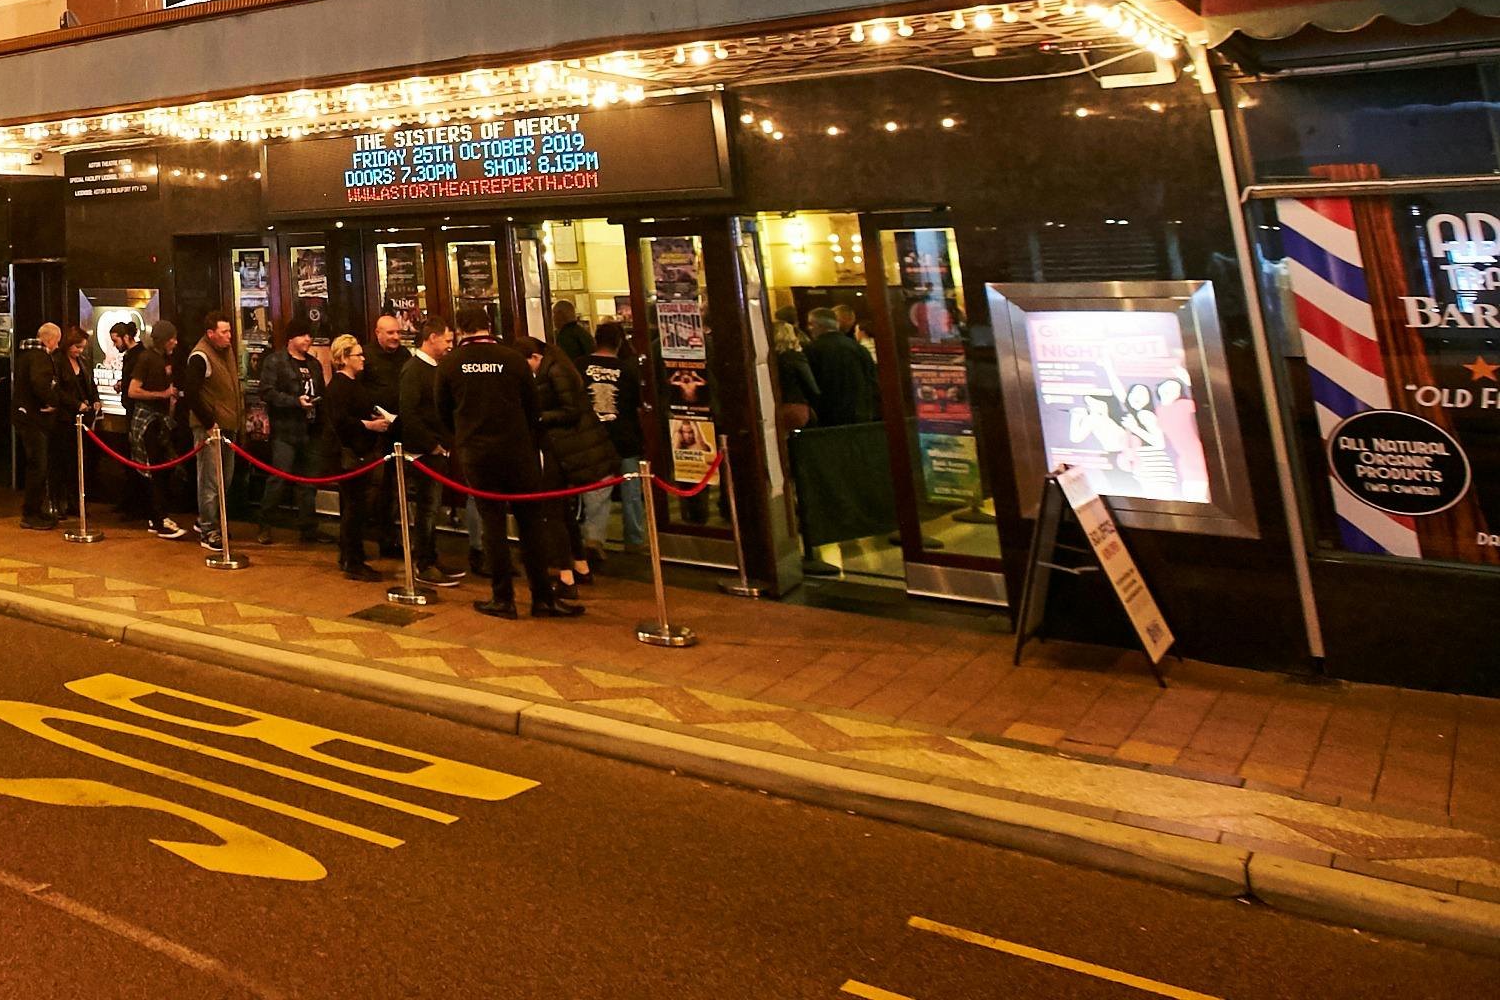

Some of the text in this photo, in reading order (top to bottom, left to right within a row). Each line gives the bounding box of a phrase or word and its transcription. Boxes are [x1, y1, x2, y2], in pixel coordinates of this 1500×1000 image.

[353, 114, 580, 151] THE SISTERS OF MERCY
[352, 133, 584, 169] FRIDAY 25TH OCTOBER 2019
[344, 152, 599, 187] DOORS: 7.30PM SHOW: 8.15PM
[347, 172, 599, 203] WWW.ASTORTHEATREPERTH.COM
[1398, 296, 1500, 329] BAR
[461, 363, 504, 373] SECURITY
[1339, 436, 1451, 456] ALL NATURAL
[1359, 451, 1434, 468] ORGANIC
[1355, 464, 1444, 482] PRODUCTS
